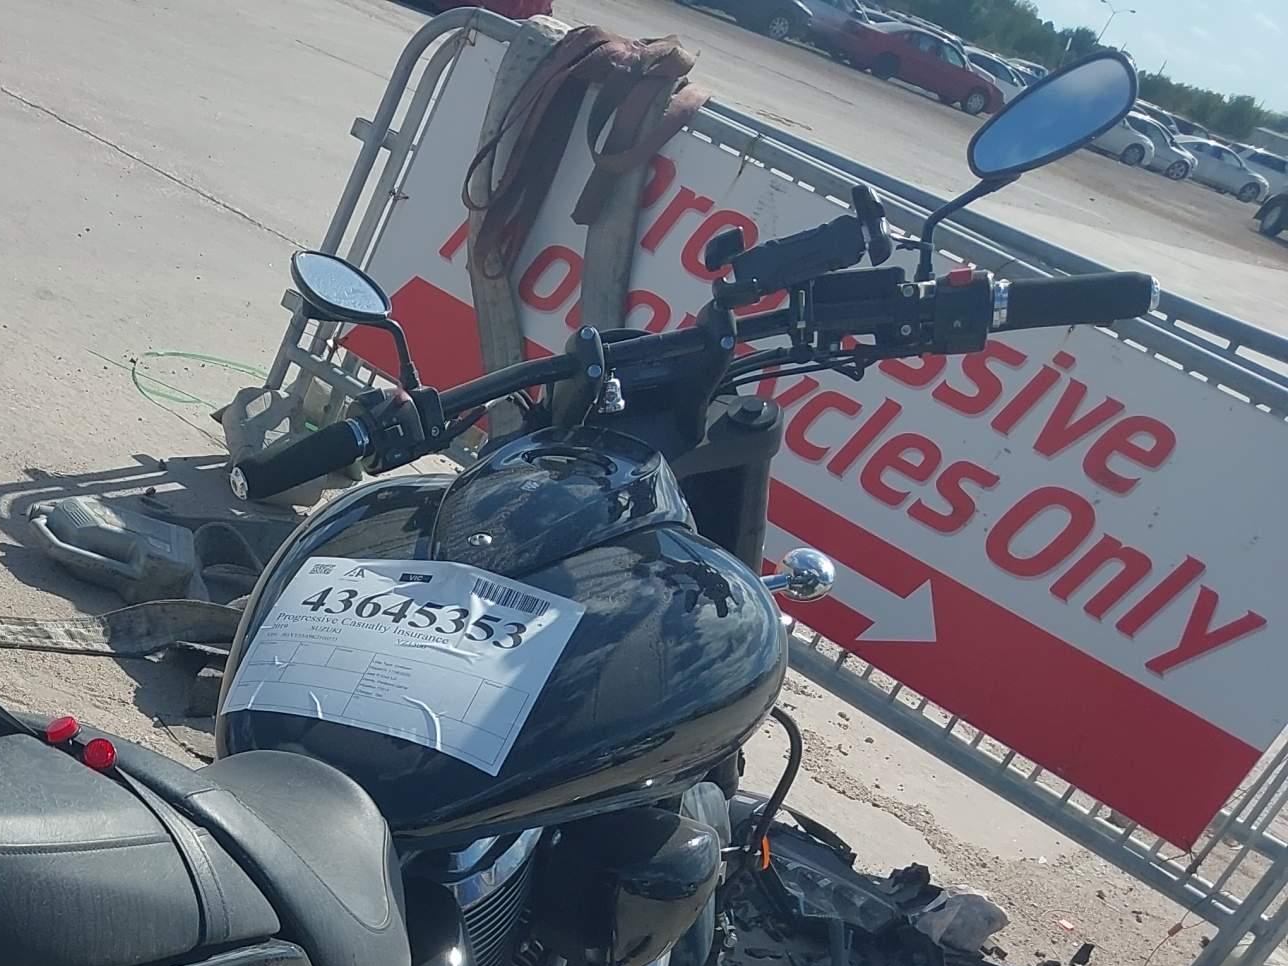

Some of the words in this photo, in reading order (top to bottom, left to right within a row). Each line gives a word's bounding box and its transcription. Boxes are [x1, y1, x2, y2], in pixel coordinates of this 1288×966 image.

[985, 485, 1268, 679] Only
[276, 611, 339, 626] Progressive
[341, 617, 390, 634] Casualty
[393, 625, 449, 645] Insurance
[301, 586, 527, 650] 43645353
[311, 625, 343, 634] SUZUKI
